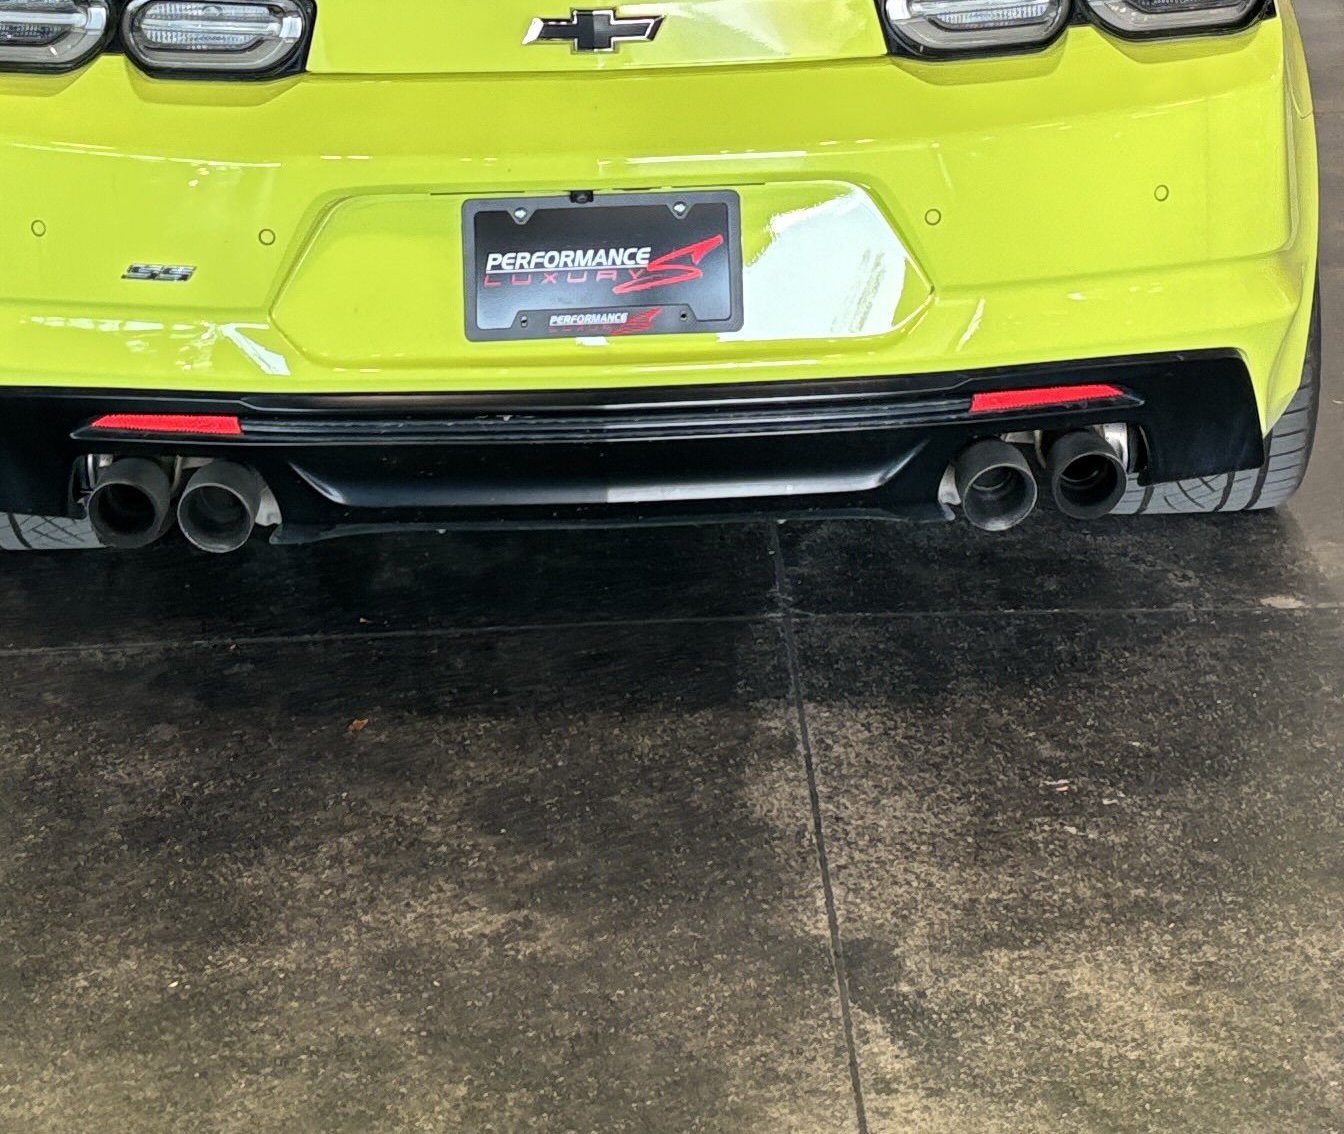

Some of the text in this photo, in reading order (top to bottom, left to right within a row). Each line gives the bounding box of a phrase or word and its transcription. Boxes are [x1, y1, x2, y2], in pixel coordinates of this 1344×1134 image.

[486, 247, 651, 270] PERFORMANCE
[121, 264, 197, 281] SS
[484, 269, 644, 287] LUXURY
[549, 312, 628, 326] PERFORMANCE
